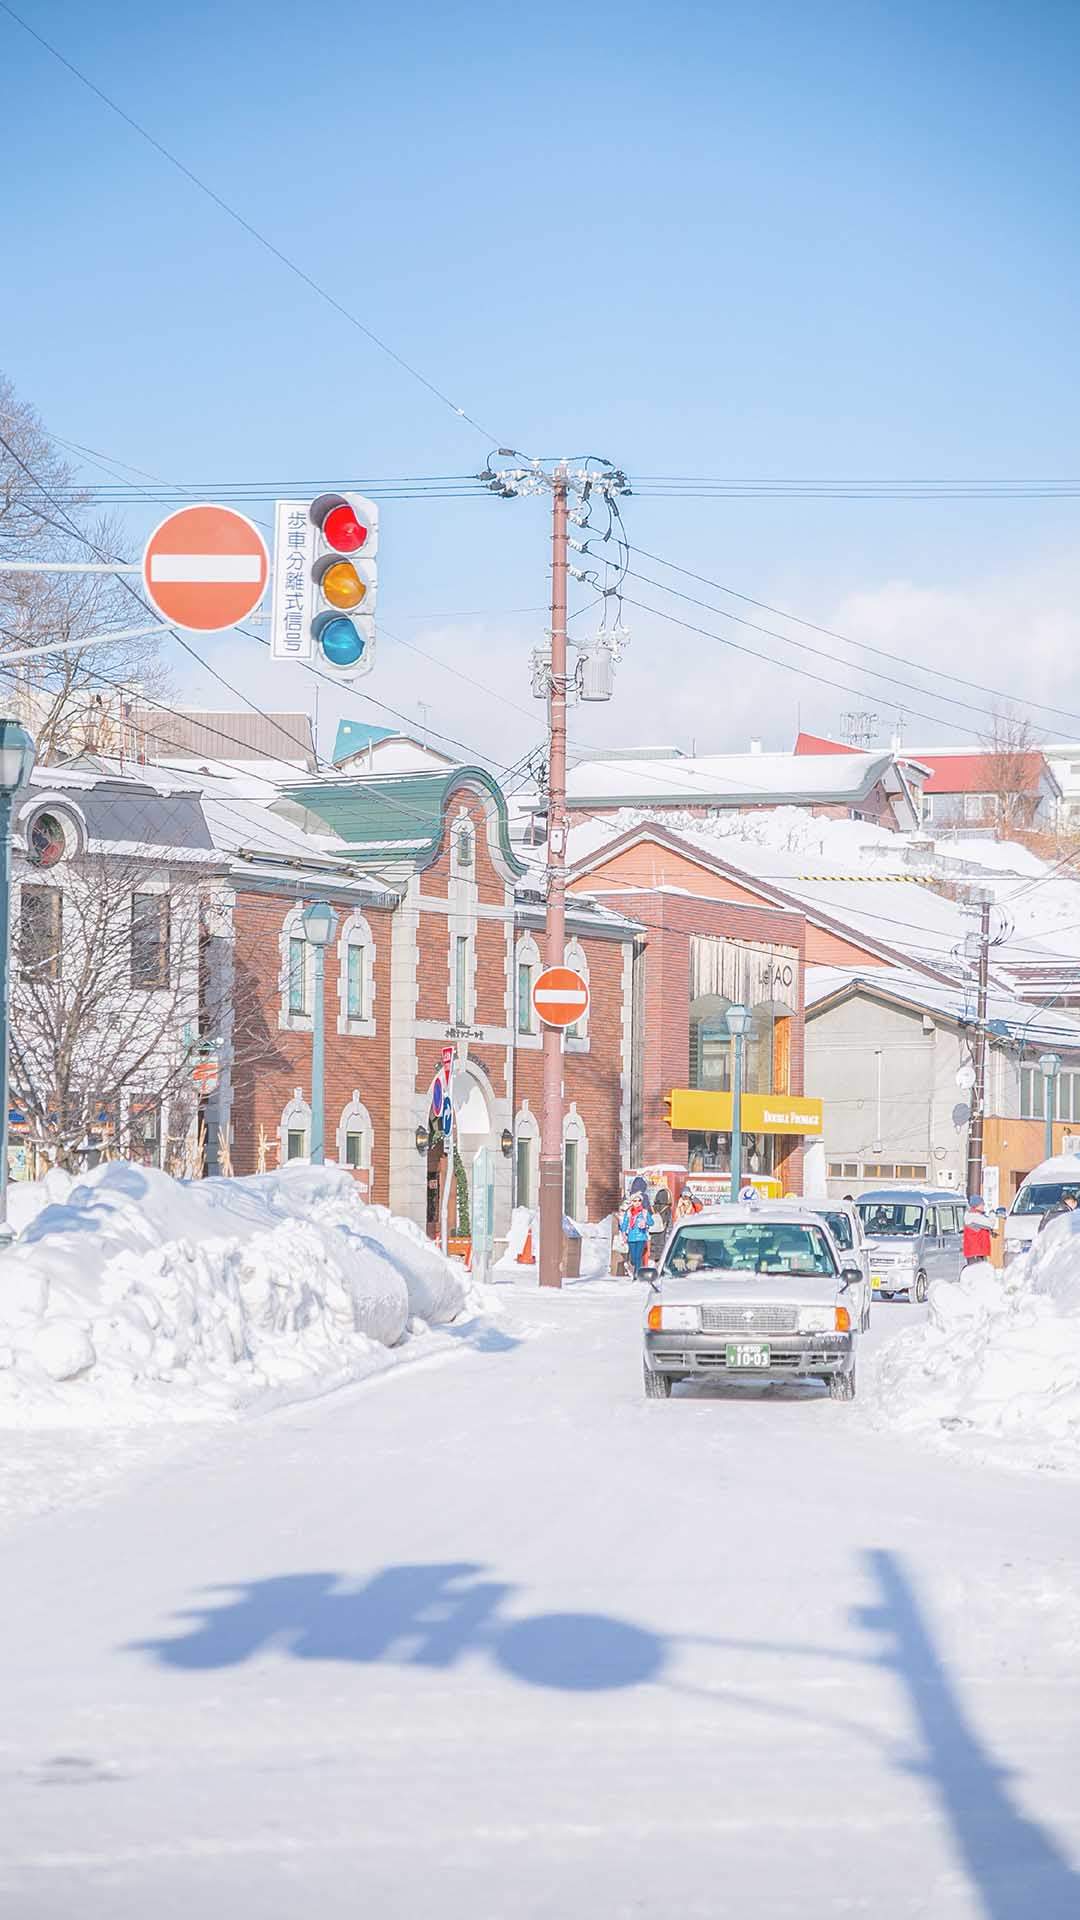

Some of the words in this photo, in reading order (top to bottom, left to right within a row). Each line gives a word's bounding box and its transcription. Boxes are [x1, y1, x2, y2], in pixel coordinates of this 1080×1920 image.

[283, 511, 307, 652] 歩車分離式信号
